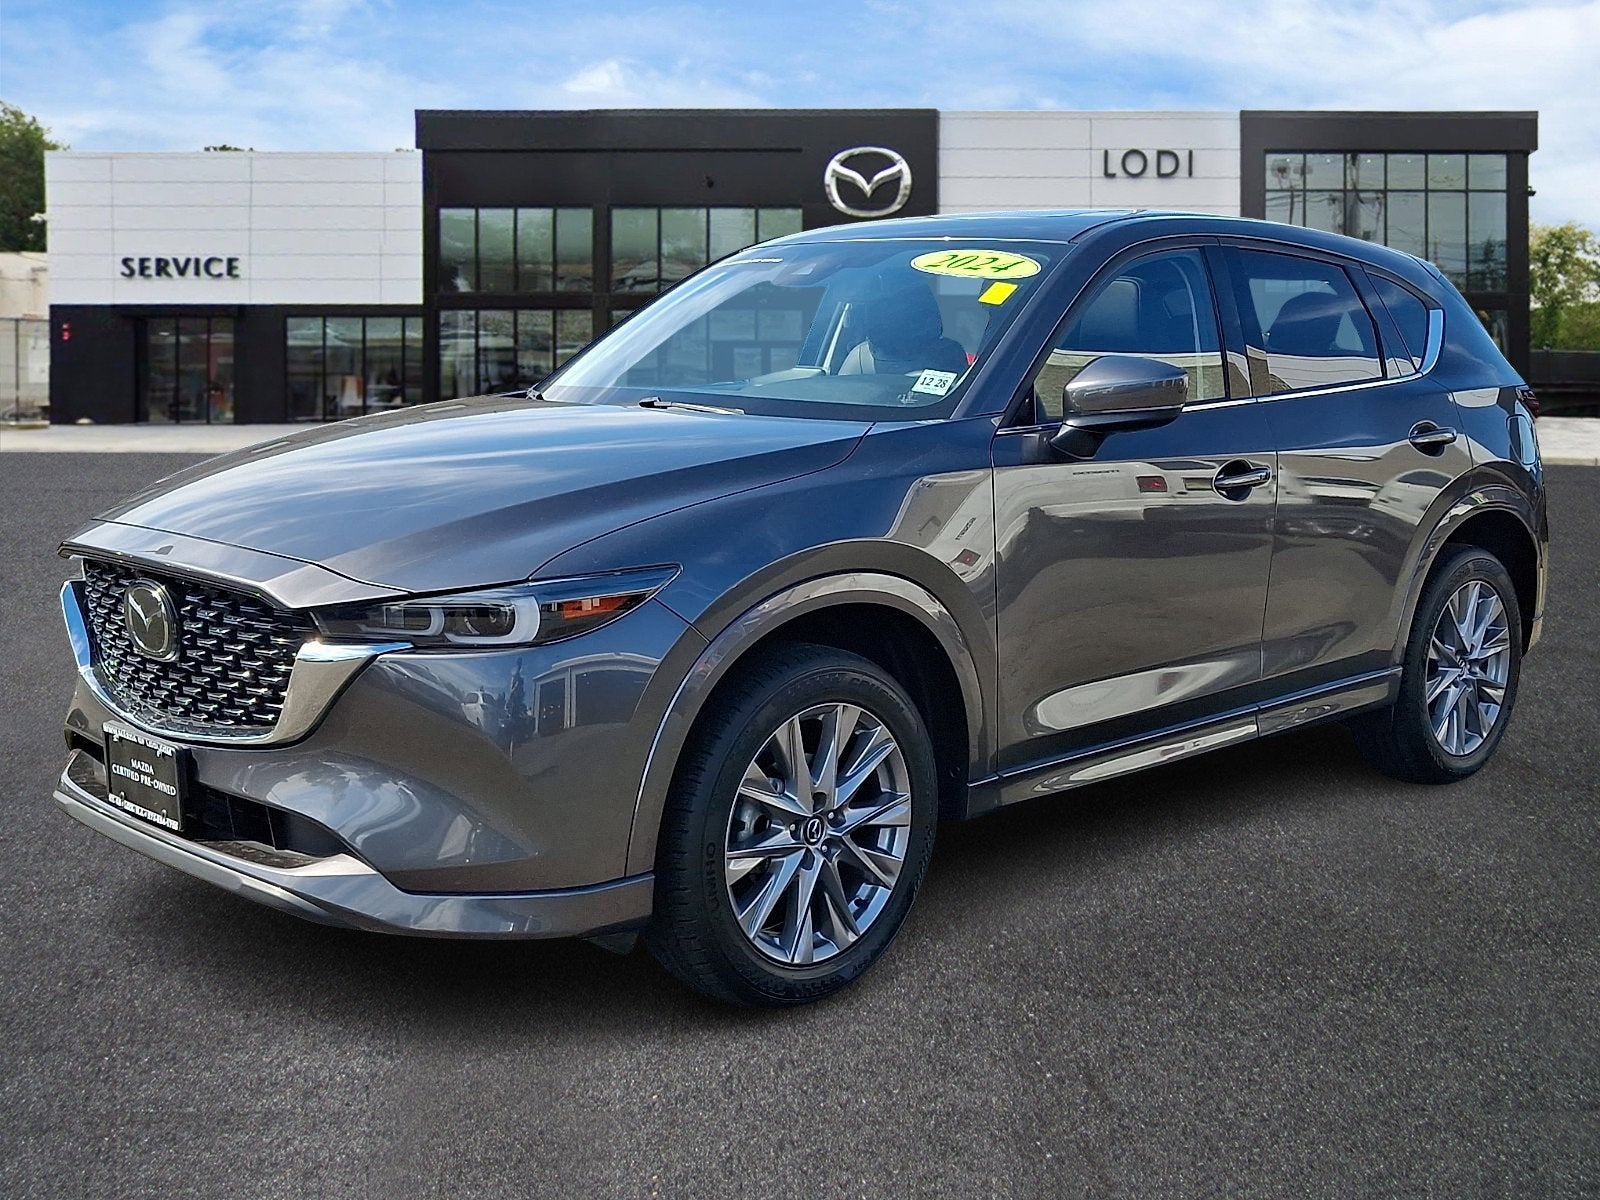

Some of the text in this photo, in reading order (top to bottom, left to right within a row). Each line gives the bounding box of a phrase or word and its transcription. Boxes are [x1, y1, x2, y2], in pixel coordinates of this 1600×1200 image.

[1103, 149, 1193, 178] LODI
[120, 257, 240, 278] SERVICE
[924, 254, 1025, 272] 2024
[919, 376, 933, 387] 12
[131, 758, 154, 776] MAZDA
[112, 763, 177, 797] CERTIFIED PRE-OWNED
